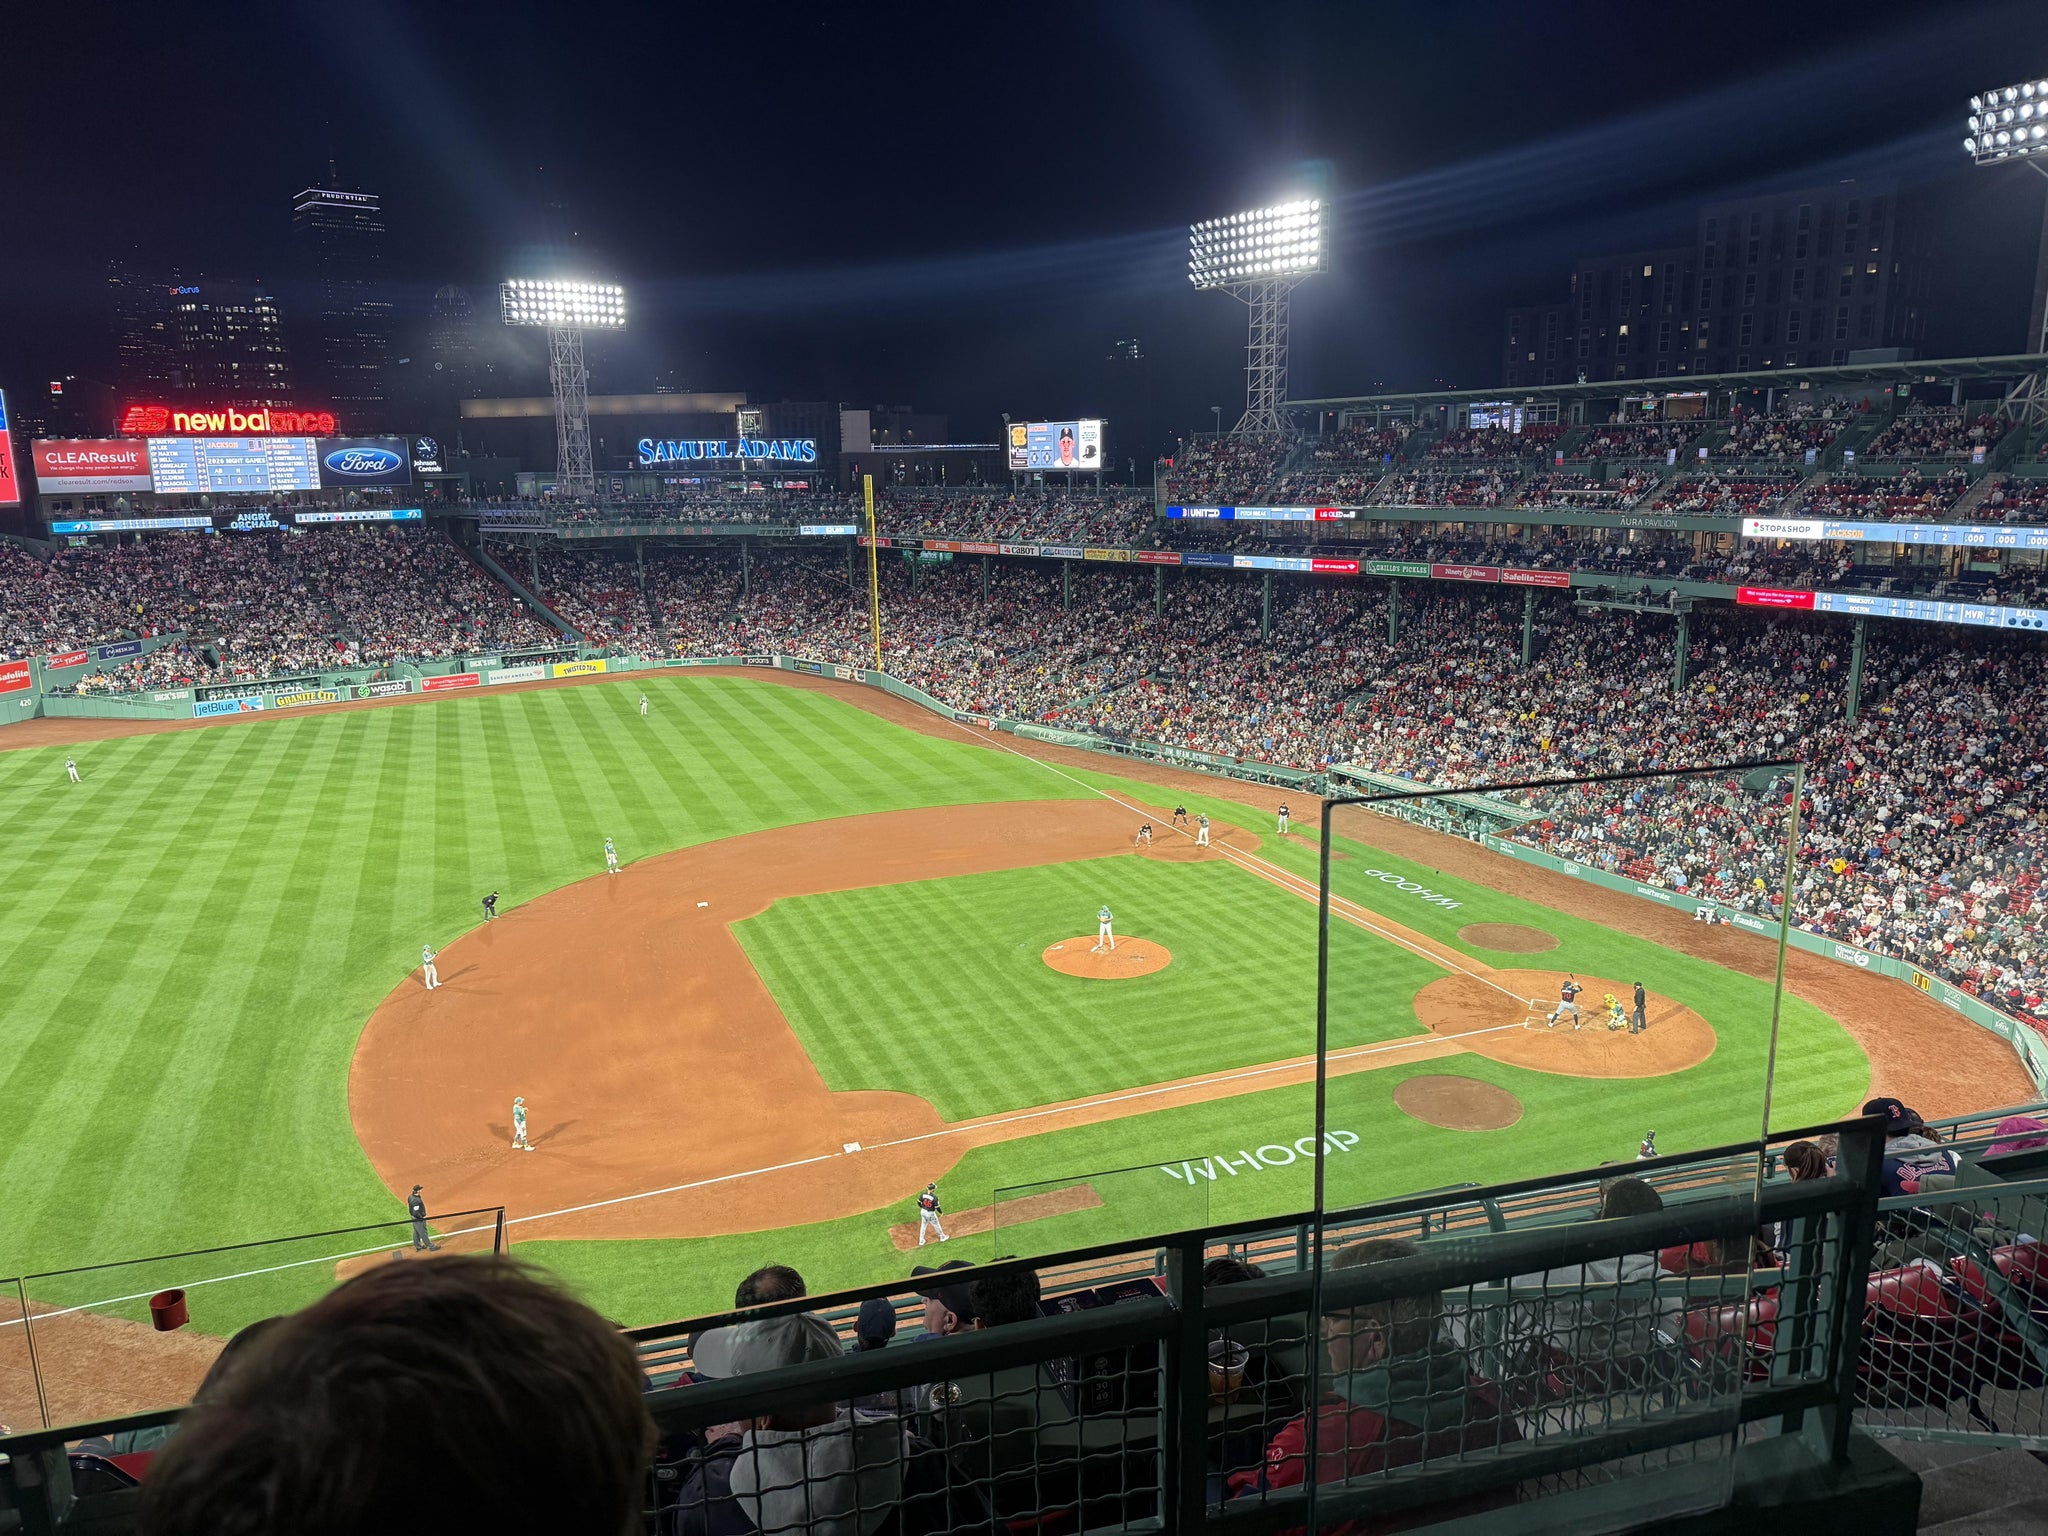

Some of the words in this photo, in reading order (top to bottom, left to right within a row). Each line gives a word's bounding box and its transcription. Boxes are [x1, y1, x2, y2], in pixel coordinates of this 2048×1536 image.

[321, 192, 367, 202] PRUDENTIAL
[173, 412, 226, 431] new
[228, 408, 334, 432] balance
[638, 438, 733, 465] SAMUEL
[735, 437, 816, 463] ADAMS
[46, 451, 137, 464] CLEAResult
[341, 452, 387, 471] Ford
[58, 478, 133, 486] clearesult.com/redsox
[237, 513, 270, 522] ANGRY
[1190, 509, 1220, 518] UNITED
[230, 519, 279, 529] ORCHARD
[1644, 518, 1678, 528] PAVILION
[1759, 524, 1811, 533] STOP&SHOP
[1826, 529, 1864, 538] JACKSON
[1913, 532, 1919, 540] 0
[1942, 533, 1948, 542] 2
[1964, 534, 1985, 543] .000
[1995, 536, 2016, 544] .000
[1376, 564, 1400, 573] GRILLO'S
[1402, 565, 1427, 574] PICKLES
[1445, 568, 1463, 577] Ninety
[1503, 572, 1535, 582] Safelite
[1845, 597, 1875, 605] MINNESOTA
[1964, 610, 1984, 620] MVR
[1990, 608, 1996, 616] 2
[2015, 610, 2037, 619] BALL
[1989, 617, 1994, 625] 2
[63, 653, 87, 665] TICKET
[617, 657, 629, 665] 380
[563, 664, 586, 675] TWISTED
[586, 664, 597, 672] TEA
[370, 682, 406, 693] wasabi
[19, 698, 32, 707] 420
[154, 693, 176, 702] DICK'S
[276, 692, 316, 707] GRANITE
[317, 690, 338, 701] CITY
[198, 702, 234, 716] jetBlue
[1364, 869, 1463, 910] WHOOP
[1637, 886, 1671, 901] smartwater
[1733, 913, 1765, 930] Franklin
[1835, 944, 1856, 956] Ninety
[1835, 950, 1854, 962] Nine
[1160, 1130, 1360, 1185] WHOOP
[1095, 1381, 1108, 1391] 30
[1095, 1391, 1109, 1401] 40
